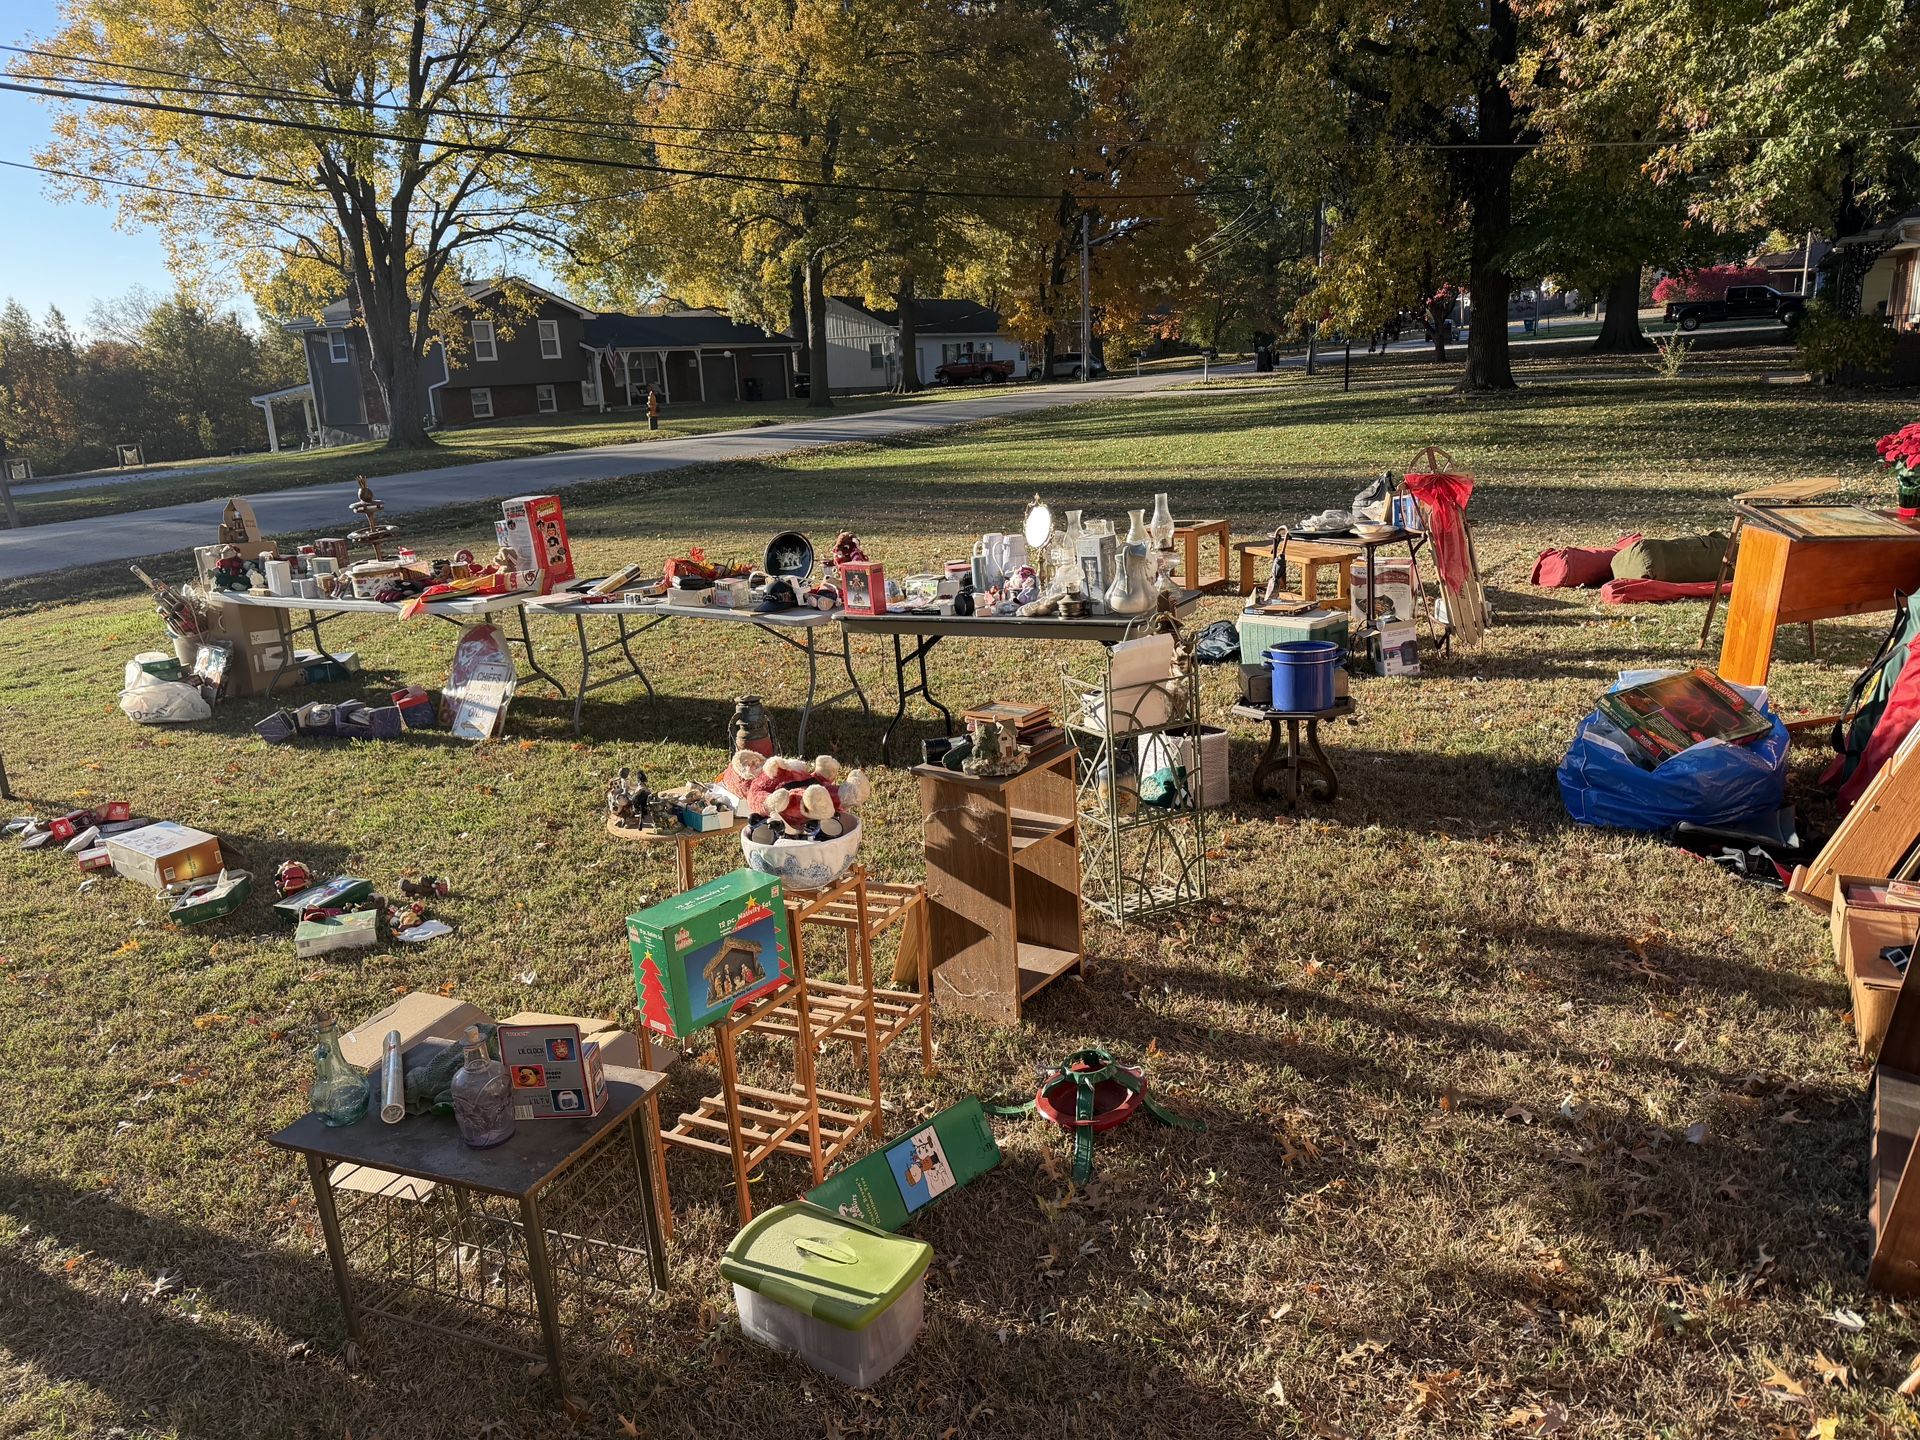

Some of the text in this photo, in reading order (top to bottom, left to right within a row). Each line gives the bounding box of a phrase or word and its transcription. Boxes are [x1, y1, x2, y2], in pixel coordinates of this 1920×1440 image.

[476, 672, 502, 683] CHIEFS
[738, 905, 761, 920] Nativity
[761, 900, 772, 909] Set
[867, 1191, 881, 1224] Christmas
